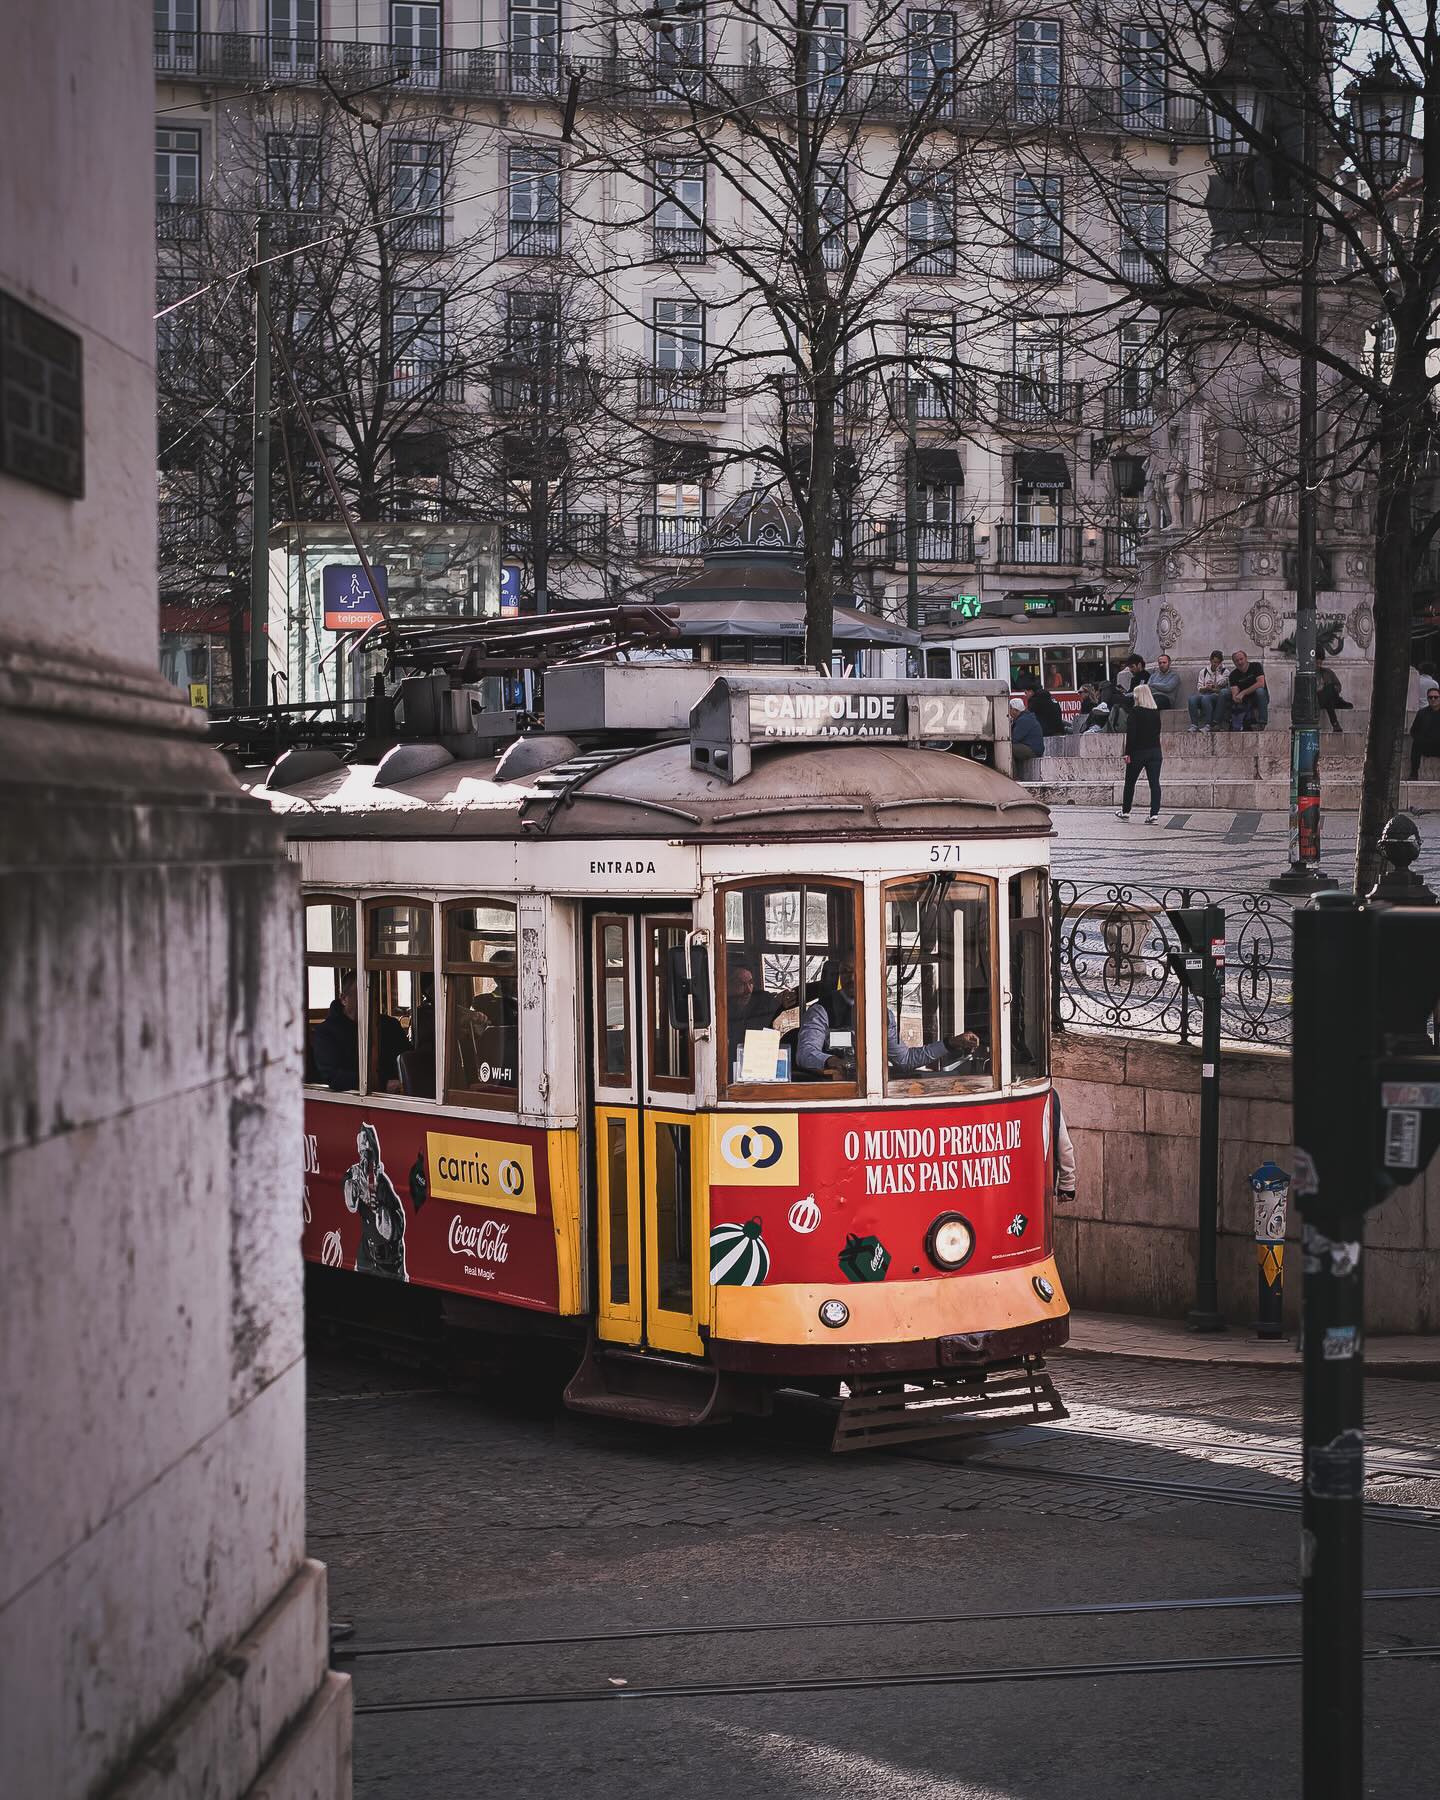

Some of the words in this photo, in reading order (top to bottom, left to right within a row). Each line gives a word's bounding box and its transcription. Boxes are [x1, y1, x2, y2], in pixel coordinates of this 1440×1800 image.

[337, 614, 374, 625] telpark
[764, 694, 895, 720] CAMPOLIDE
[923, 698, 968, 734] 24
[929, 845, 961, 863] 571
[589, 861, 656, 874] ENTRADA
[491, 1067, 512, 1081] WI-FI
[844, 1131, 860, 1161] O
[864, 1127, 936, 1161] MUNDO
[938, 1122, 1004, 1157] PRECISA
[1005, 1119, 1021, 1149] DE
[438, 1152, 490, 1186] carris
[865, 1163, 915, 1195] MAIS
[918, 1160, 959, 1192] PAIS
[961, 1154, 1011, 1189] NATAIS
[448, 1214, 510, 1264] Coca-Cola
[464, 1265, 478, 1276] Real
[477, 1268, 496, 1281] Magic
